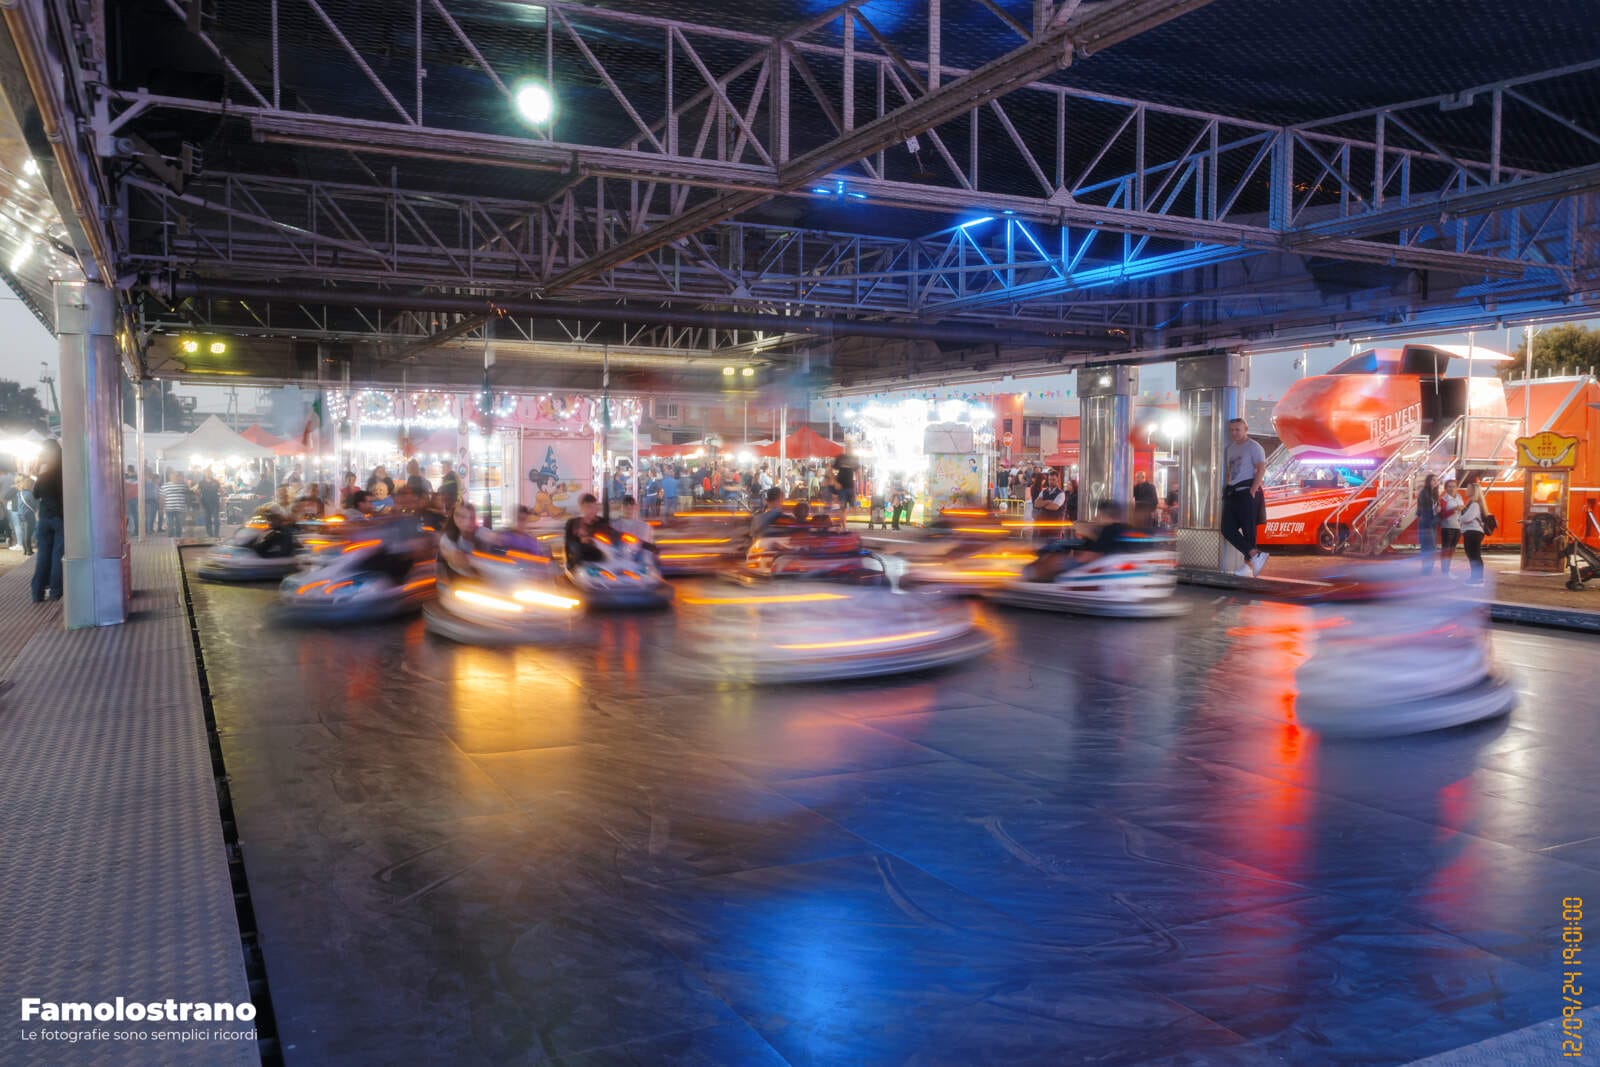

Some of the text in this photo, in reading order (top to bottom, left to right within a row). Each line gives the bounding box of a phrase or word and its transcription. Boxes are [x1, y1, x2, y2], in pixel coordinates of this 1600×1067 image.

[1369, 414, 1392, 441] RED
[1265, 521, 1305, 533] RED VECTOR
